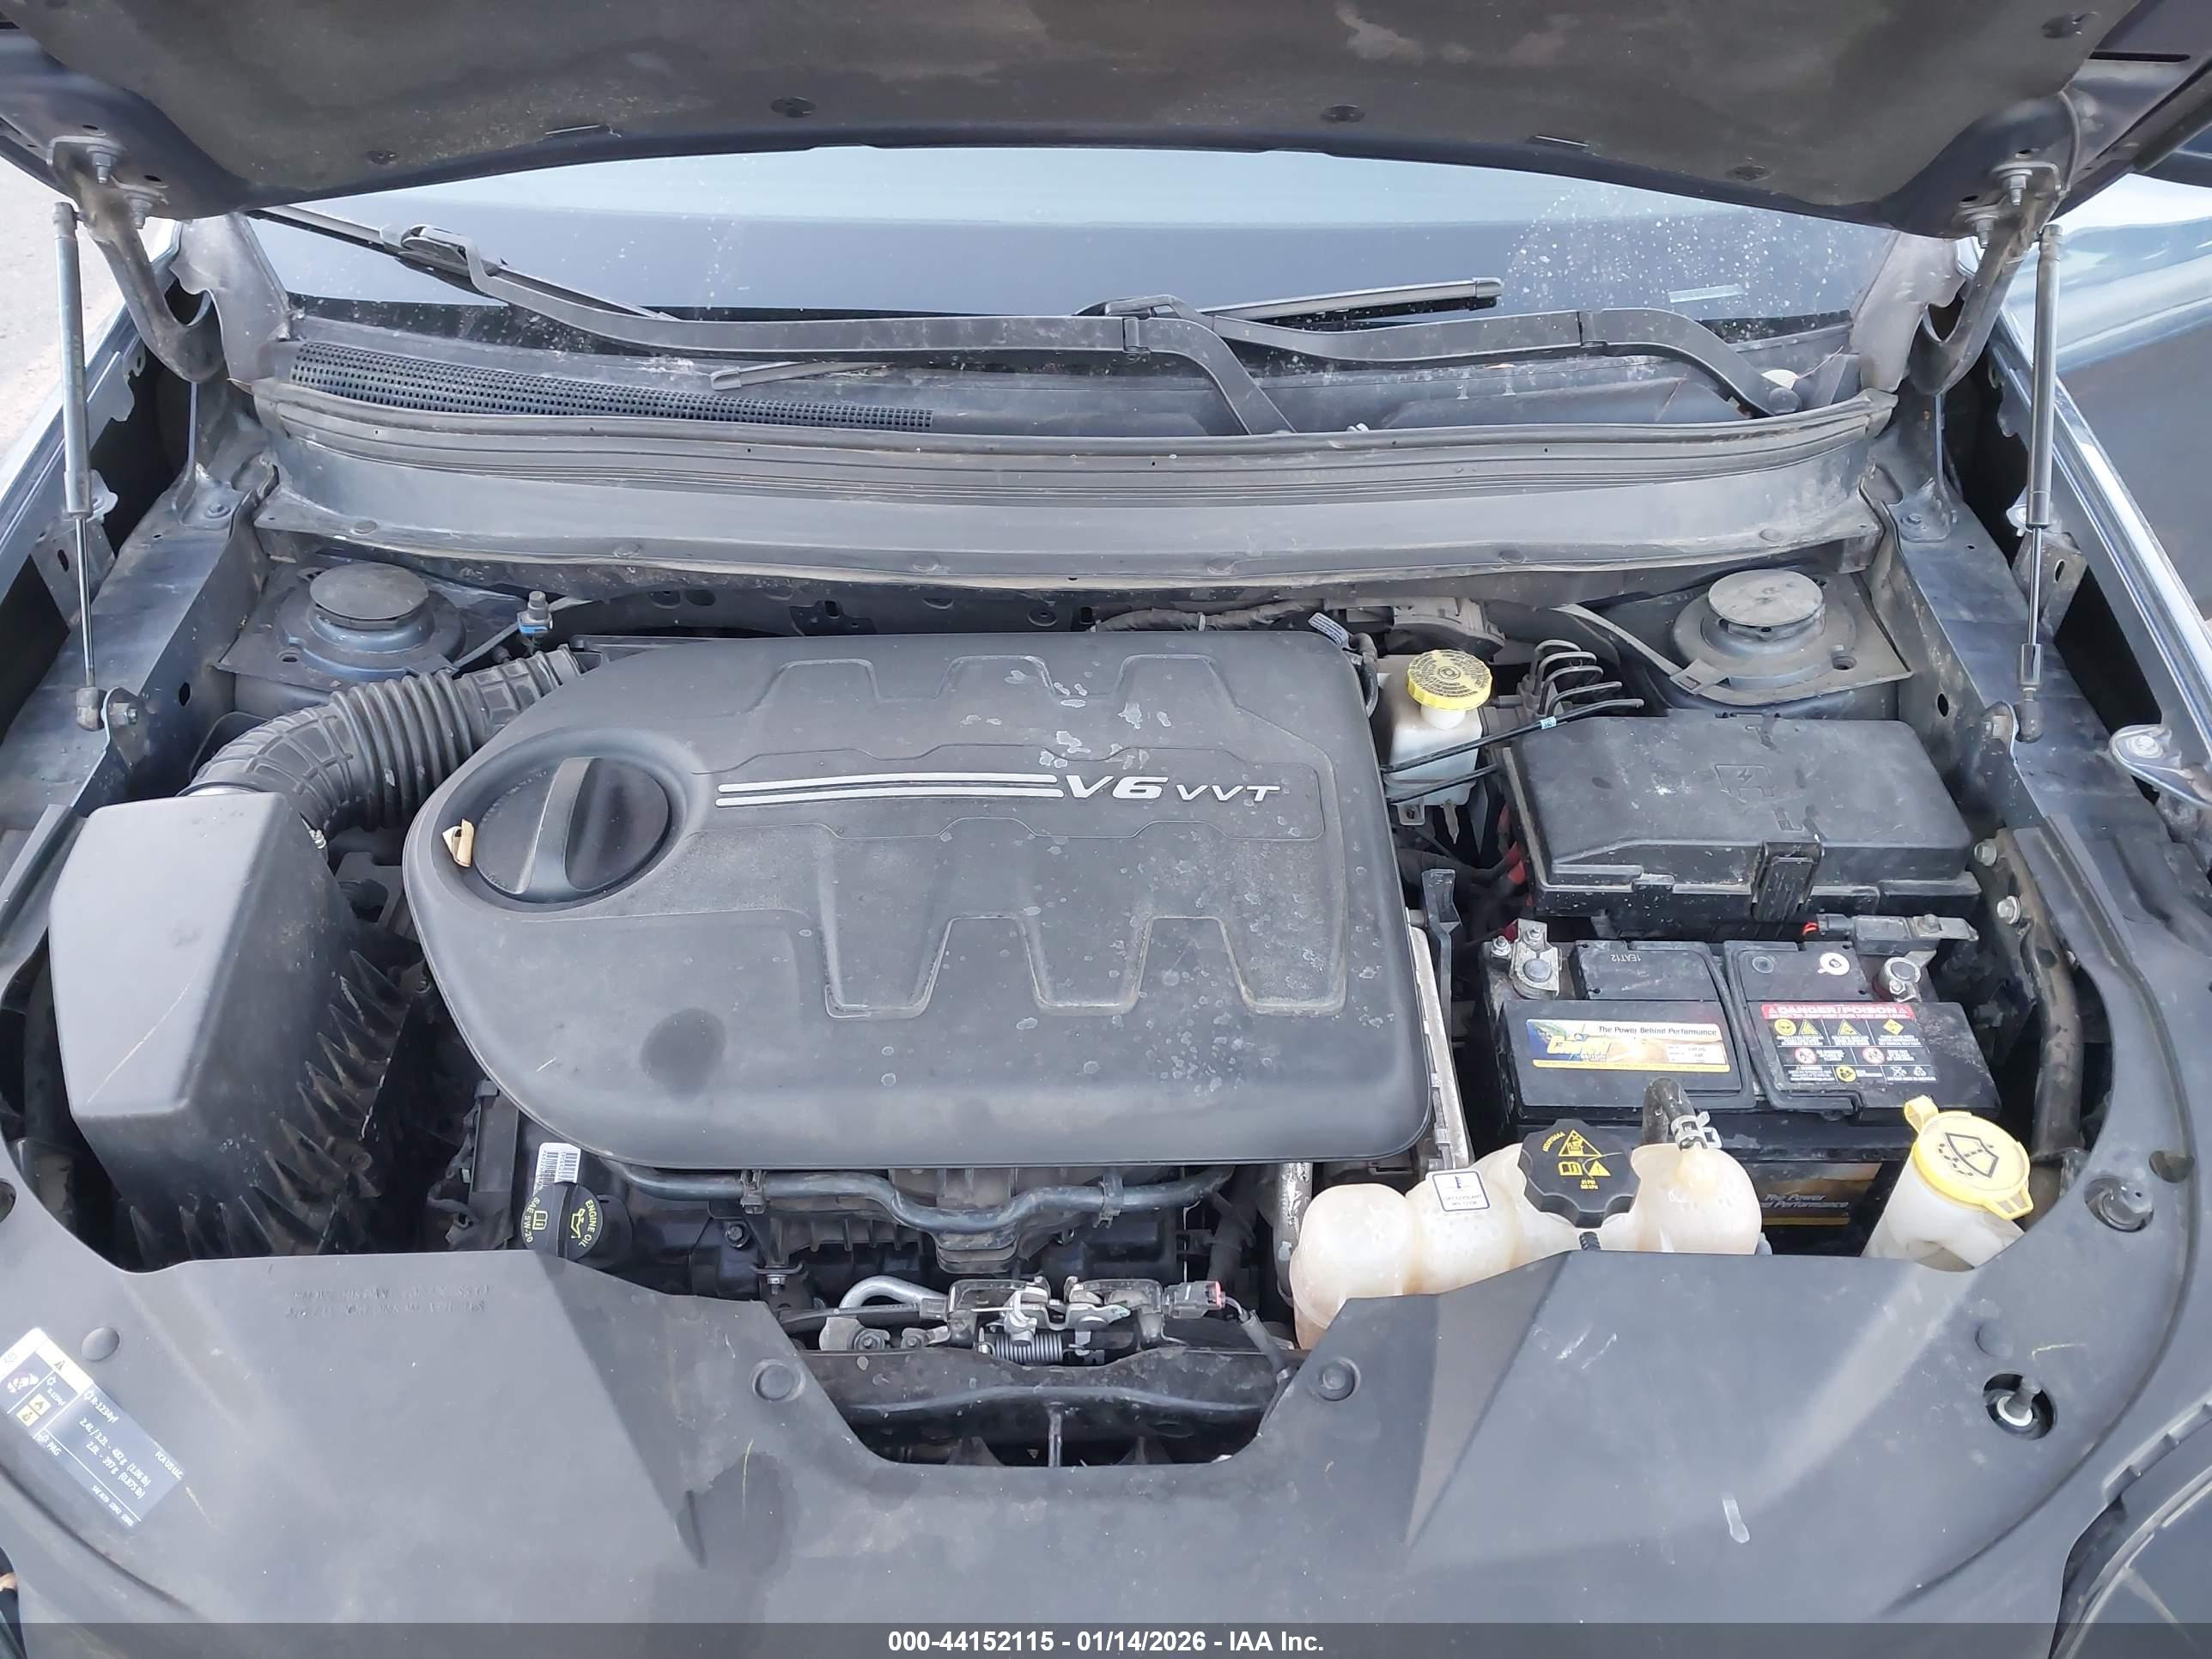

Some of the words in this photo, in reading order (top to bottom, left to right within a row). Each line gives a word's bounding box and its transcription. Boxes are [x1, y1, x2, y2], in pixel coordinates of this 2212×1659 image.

[1066, 775, 1169, 799] V6
[1176, 785, 1281, 802] VVT
[1610, 954, 1642, 963] 1EAT12
[1640, 1026, 1666, 1035] Behind
[1668, 1028, 1717, 1036] Performance
[526, 1197, 540, 1214] SAE
[585, 1199, 598, 1233] ENGINE
[522, 1215, 533, 1243] 5W-20
[578, 1234, 592, 1248] OIL
[46, 1441, 62, 1456] PAG
